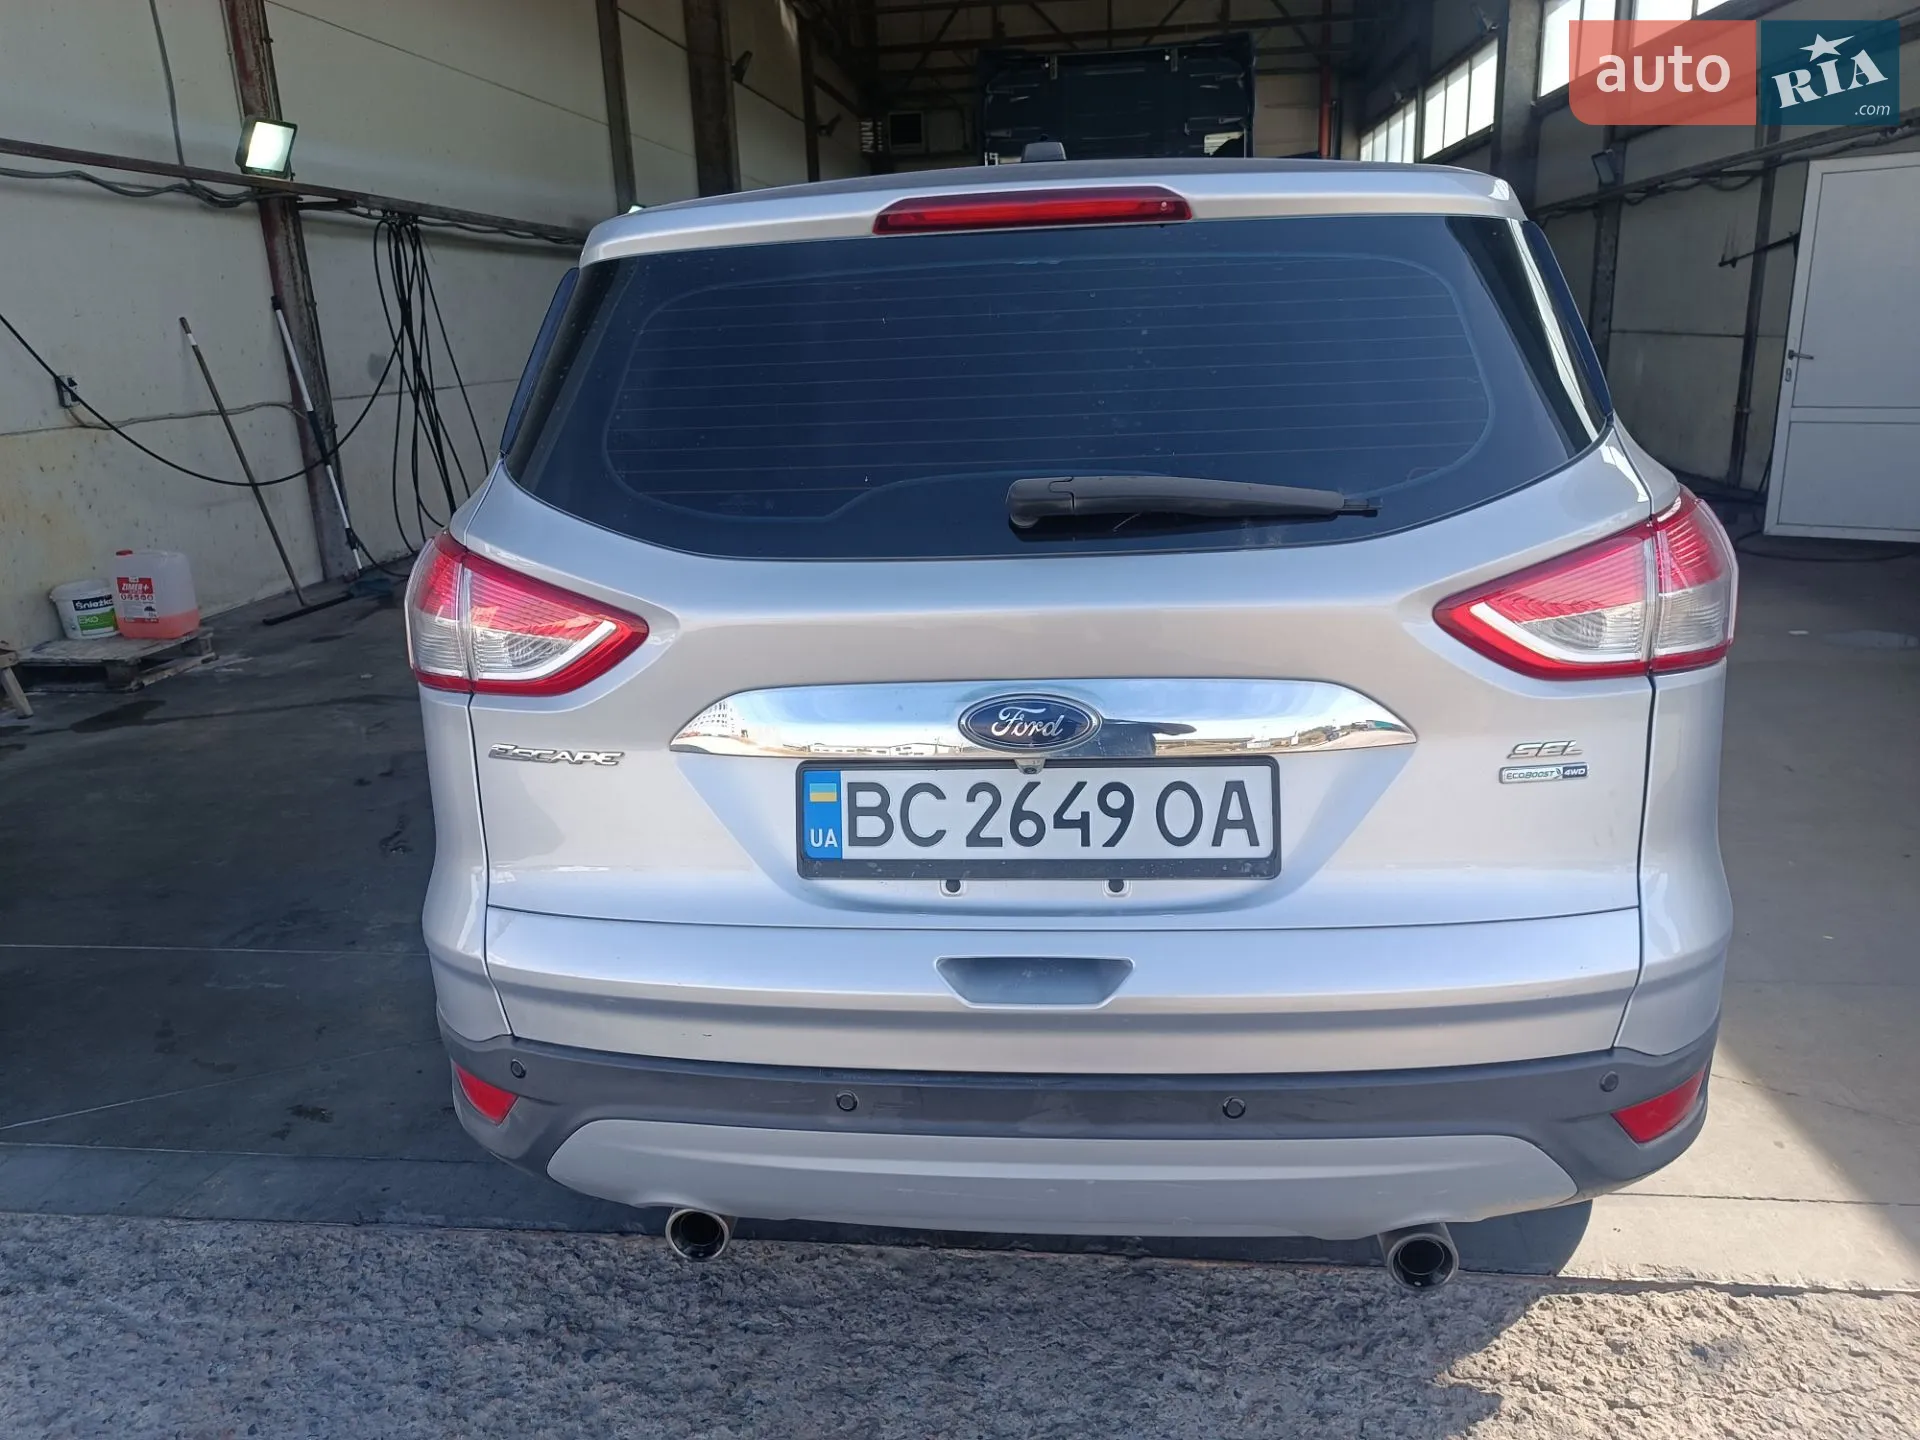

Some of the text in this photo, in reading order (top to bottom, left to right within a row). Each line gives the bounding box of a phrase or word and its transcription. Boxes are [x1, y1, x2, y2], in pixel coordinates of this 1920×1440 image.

[991, 706, 1065, 737] Ford
[488, 743, 625, 766] ESCAPE
[1506, 739, 1584, 760] SEL
[1506, 767, 1586, 780] ECOBOOST 4WD
[847, 779, 1260, 848] BC 2649 OA
[809, 828, 839, 849] UA
